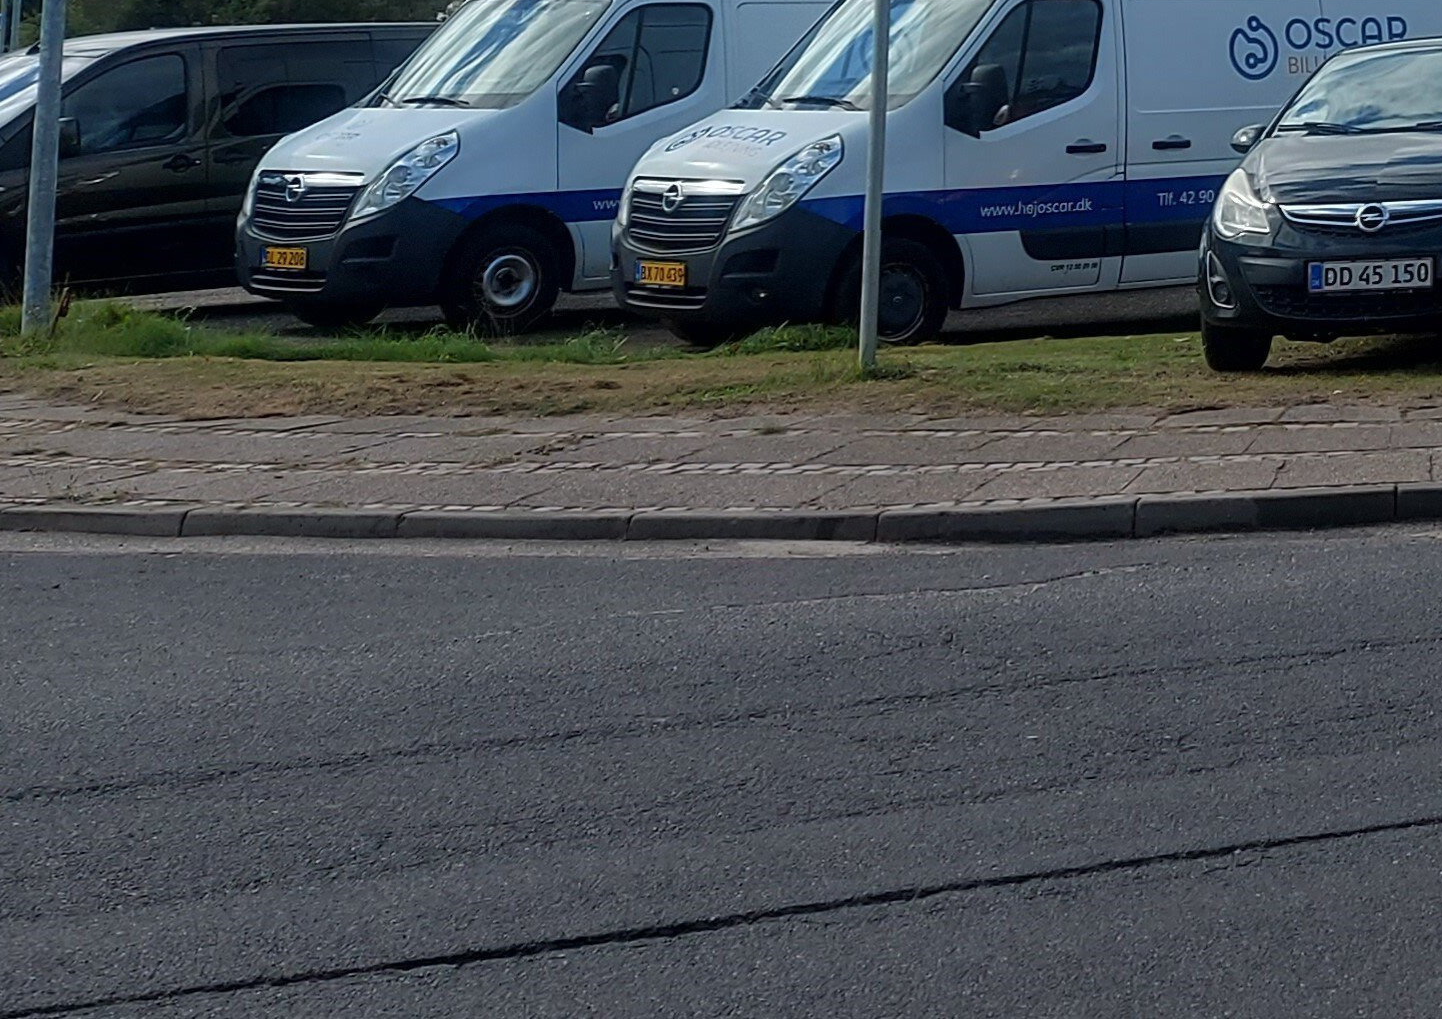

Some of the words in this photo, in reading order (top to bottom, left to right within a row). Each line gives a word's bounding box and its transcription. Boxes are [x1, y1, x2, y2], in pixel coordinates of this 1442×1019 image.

[1284, 16, 1407, 50] OSCAR
[706, 126, 788, 146] OSCAR
[1180, 191, 1196, 204] 42
[1198, 189, 1215, 203] 90
[1324, 266, 1353, 287] DD
[1358, 264, 1384, 286] 45
[1391, 262, 1430, 284] 150
